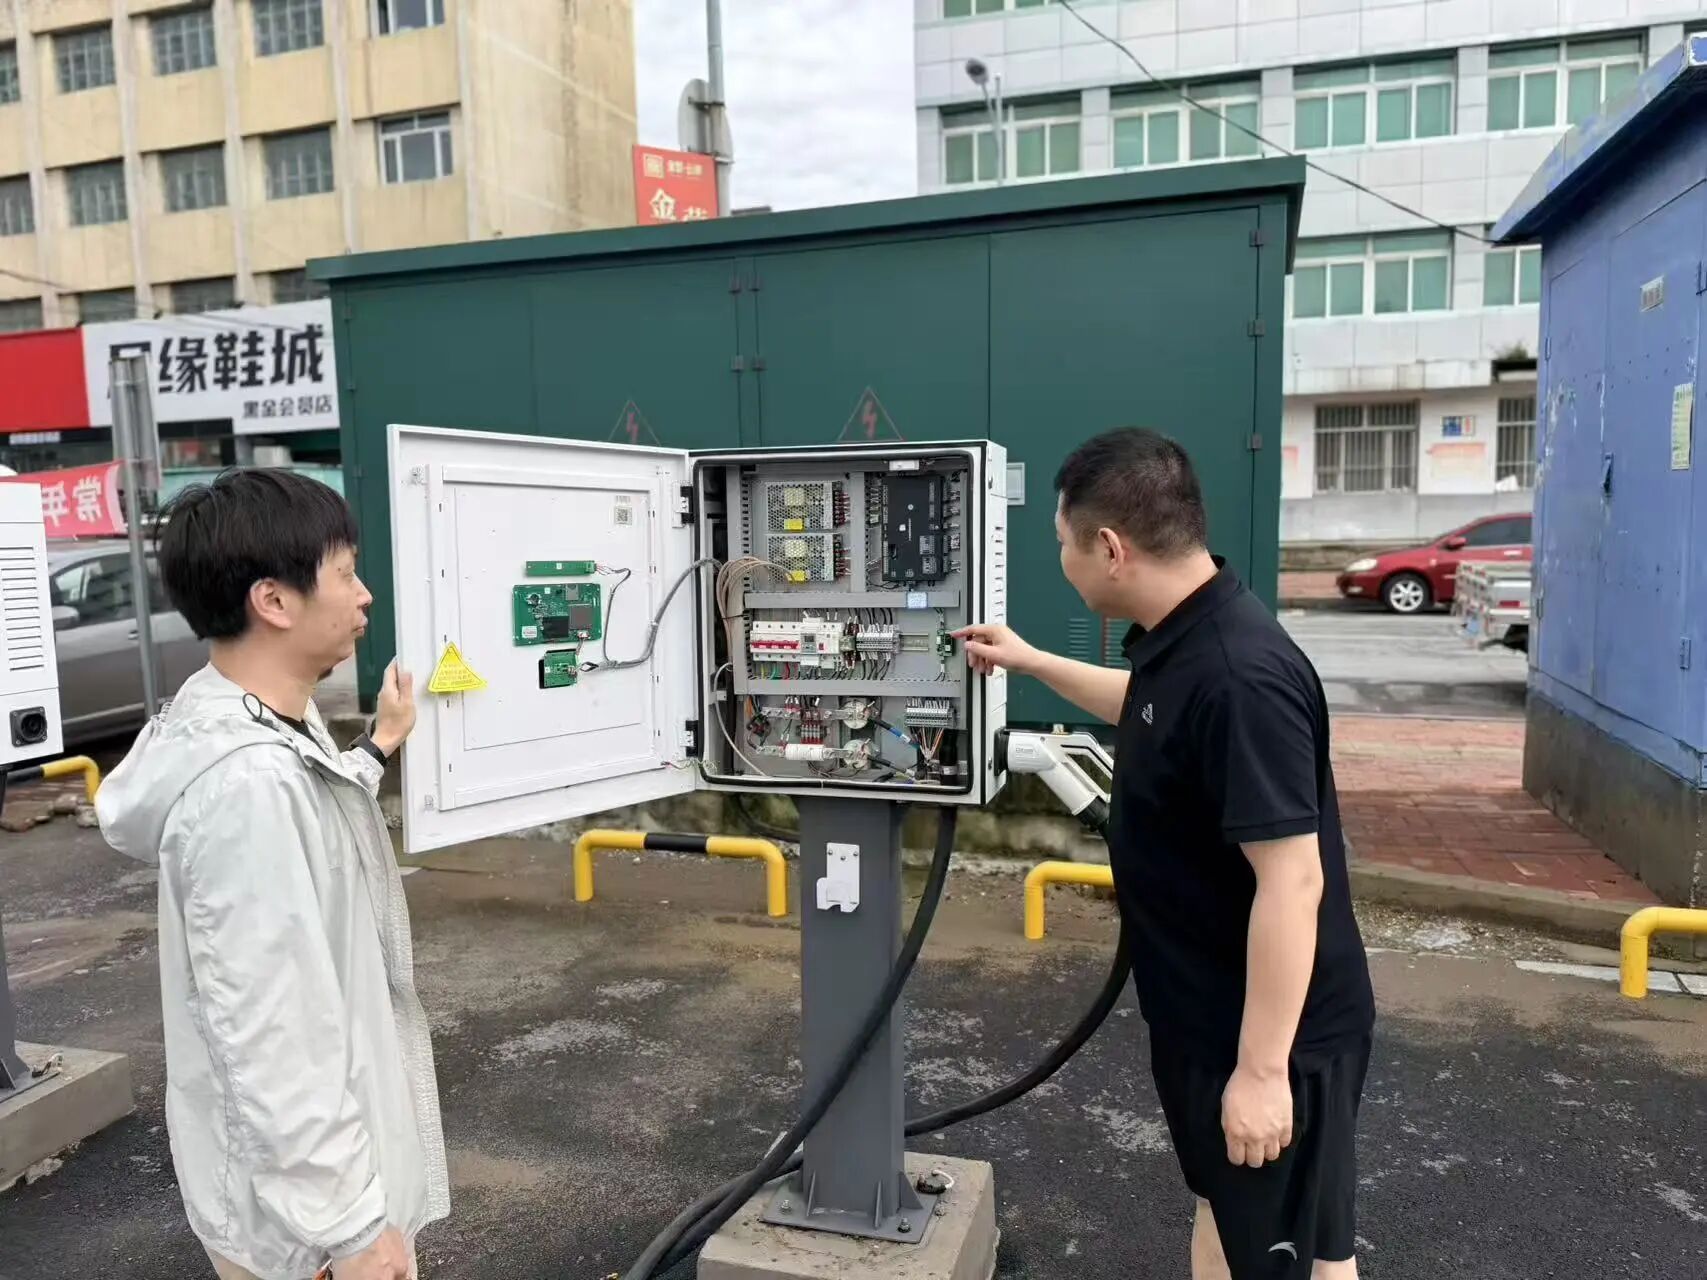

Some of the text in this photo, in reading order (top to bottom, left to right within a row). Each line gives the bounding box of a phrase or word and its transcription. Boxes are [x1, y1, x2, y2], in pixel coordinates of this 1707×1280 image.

[109, 323, 324, 396] 缘鞋城
[243, 394, 332, 419] 黑金会员店
